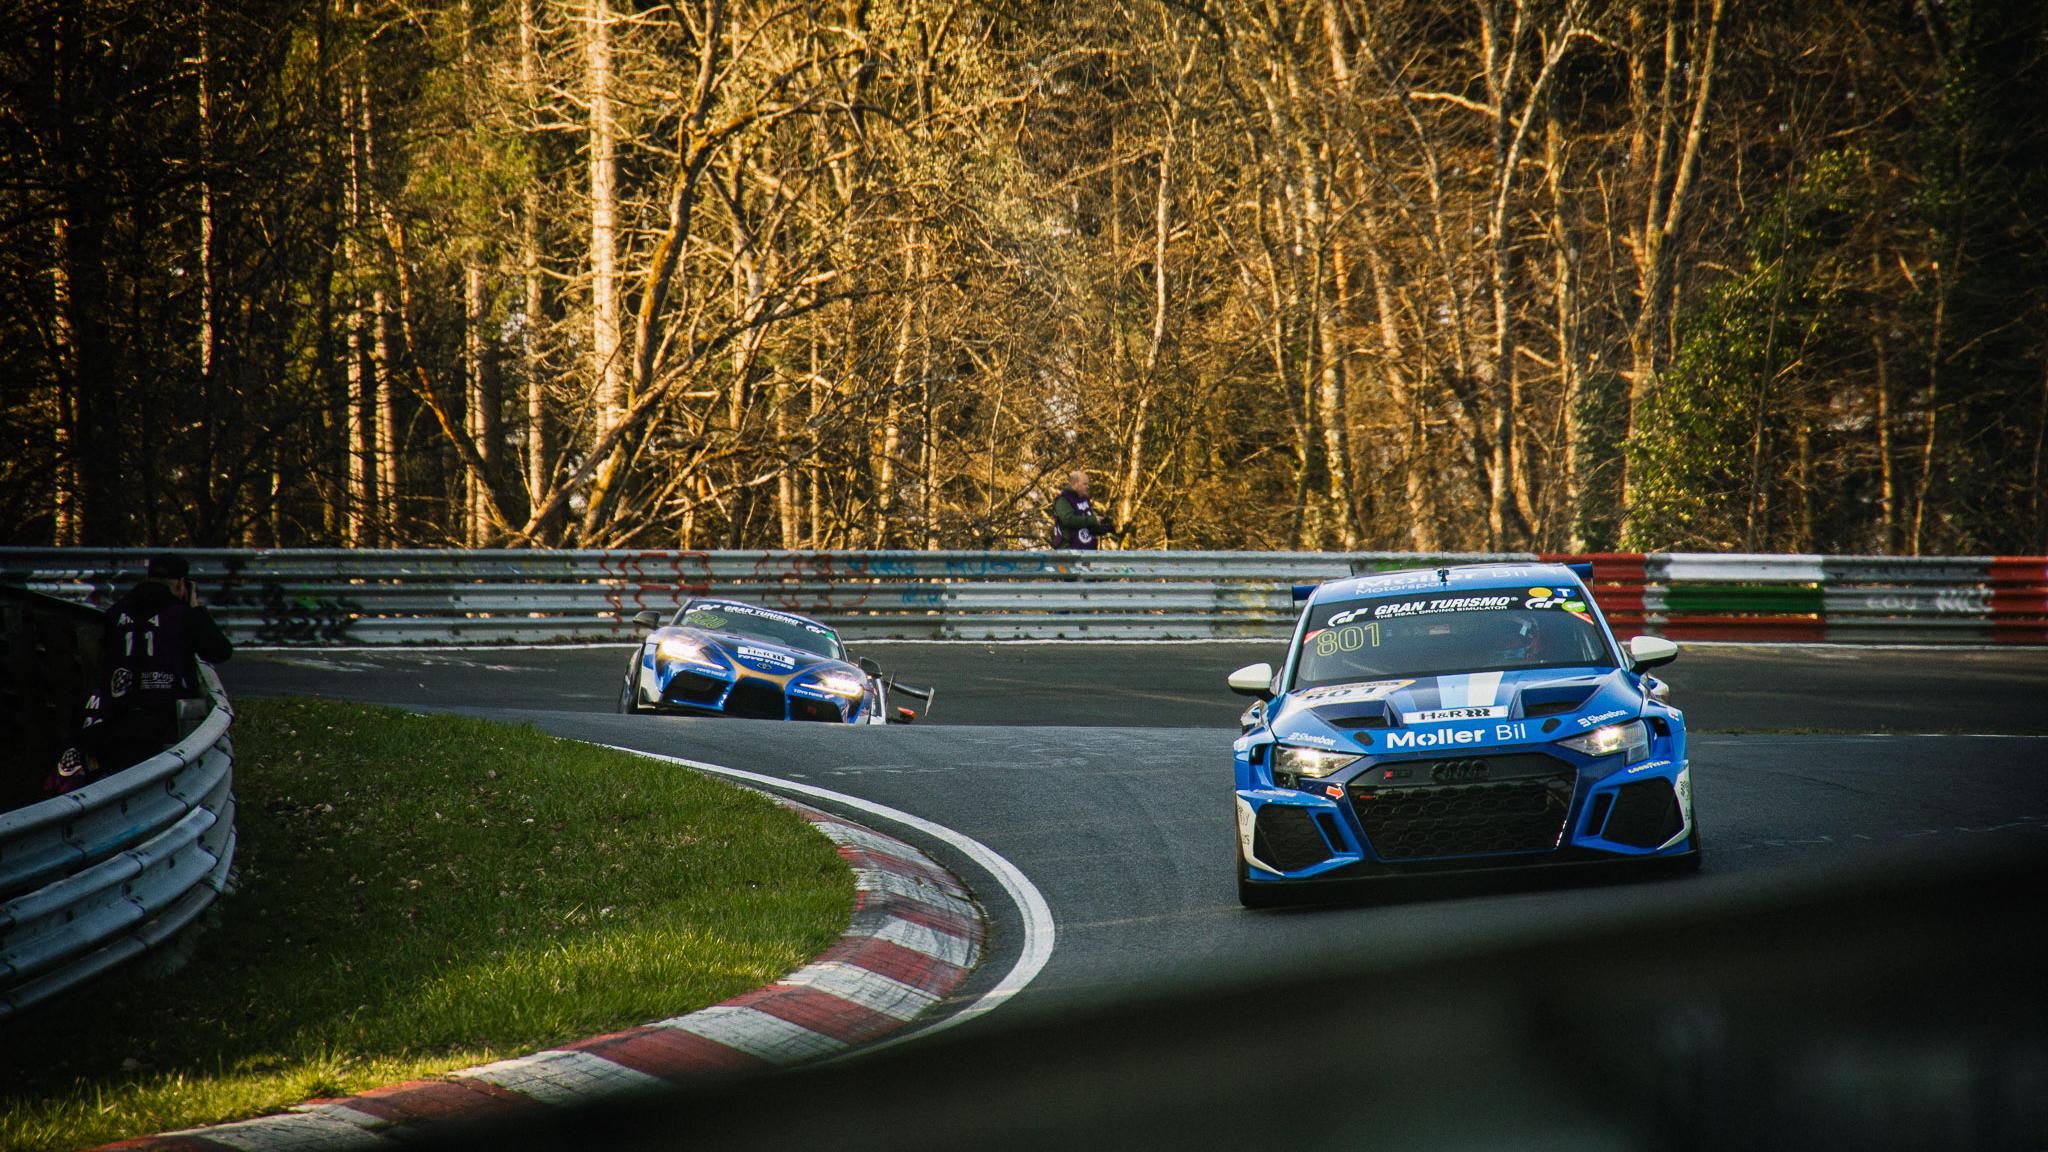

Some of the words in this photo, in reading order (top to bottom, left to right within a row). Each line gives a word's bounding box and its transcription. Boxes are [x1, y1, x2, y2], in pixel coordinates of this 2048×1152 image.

[1557, 588, 1571, 597] T
[723, 605, 753, 616] GRAN
[1374, 600, 1426, 615] GRAN
[1419, 608, 1455, 616] DRIVING
[1456, 604, 1508, 613] SIMULATOR
[1316, 622, 1380, 657] 801
[1420, 710, 1463, 721] H&R
[1587, 709, 1629, 724] Sharebox
[1495, 723, 1527, 741] Bil
